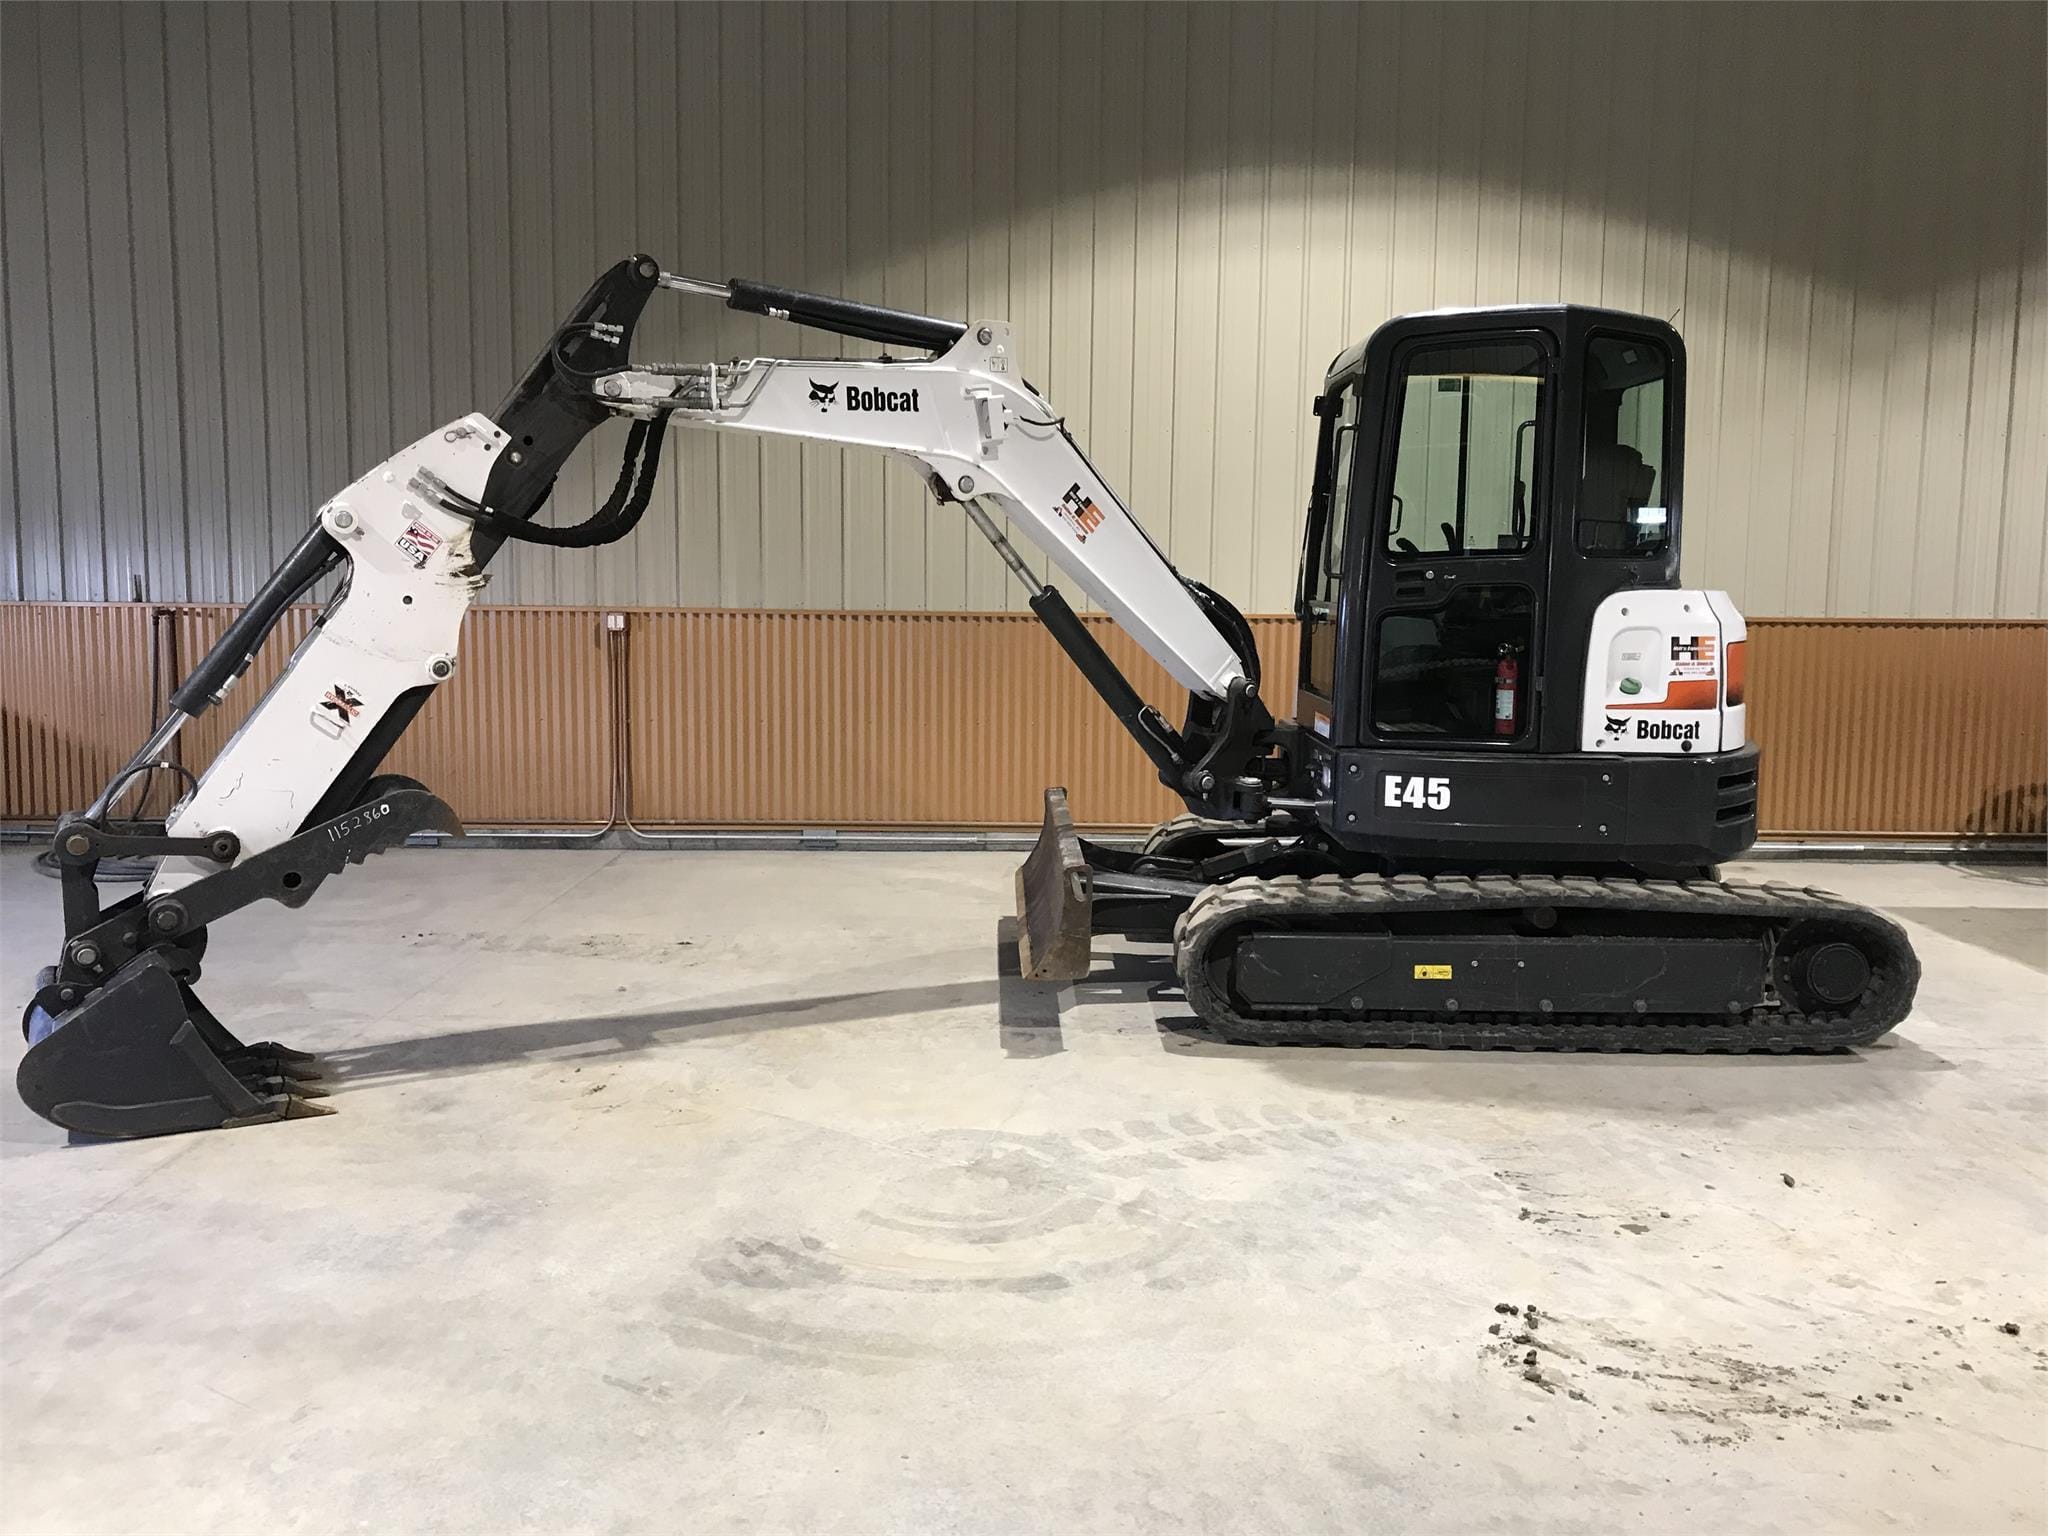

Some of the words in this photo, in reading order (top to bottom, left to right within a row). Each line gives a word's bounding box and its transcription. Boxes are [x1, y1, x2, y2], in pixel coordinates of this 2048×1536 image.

[846, 386, 919, 412] Bobcat
[399, 537, 425, 562] USA
[1637, 719, 1700, 739] Bobcat
[1384, 775, 1451, 810] E45
